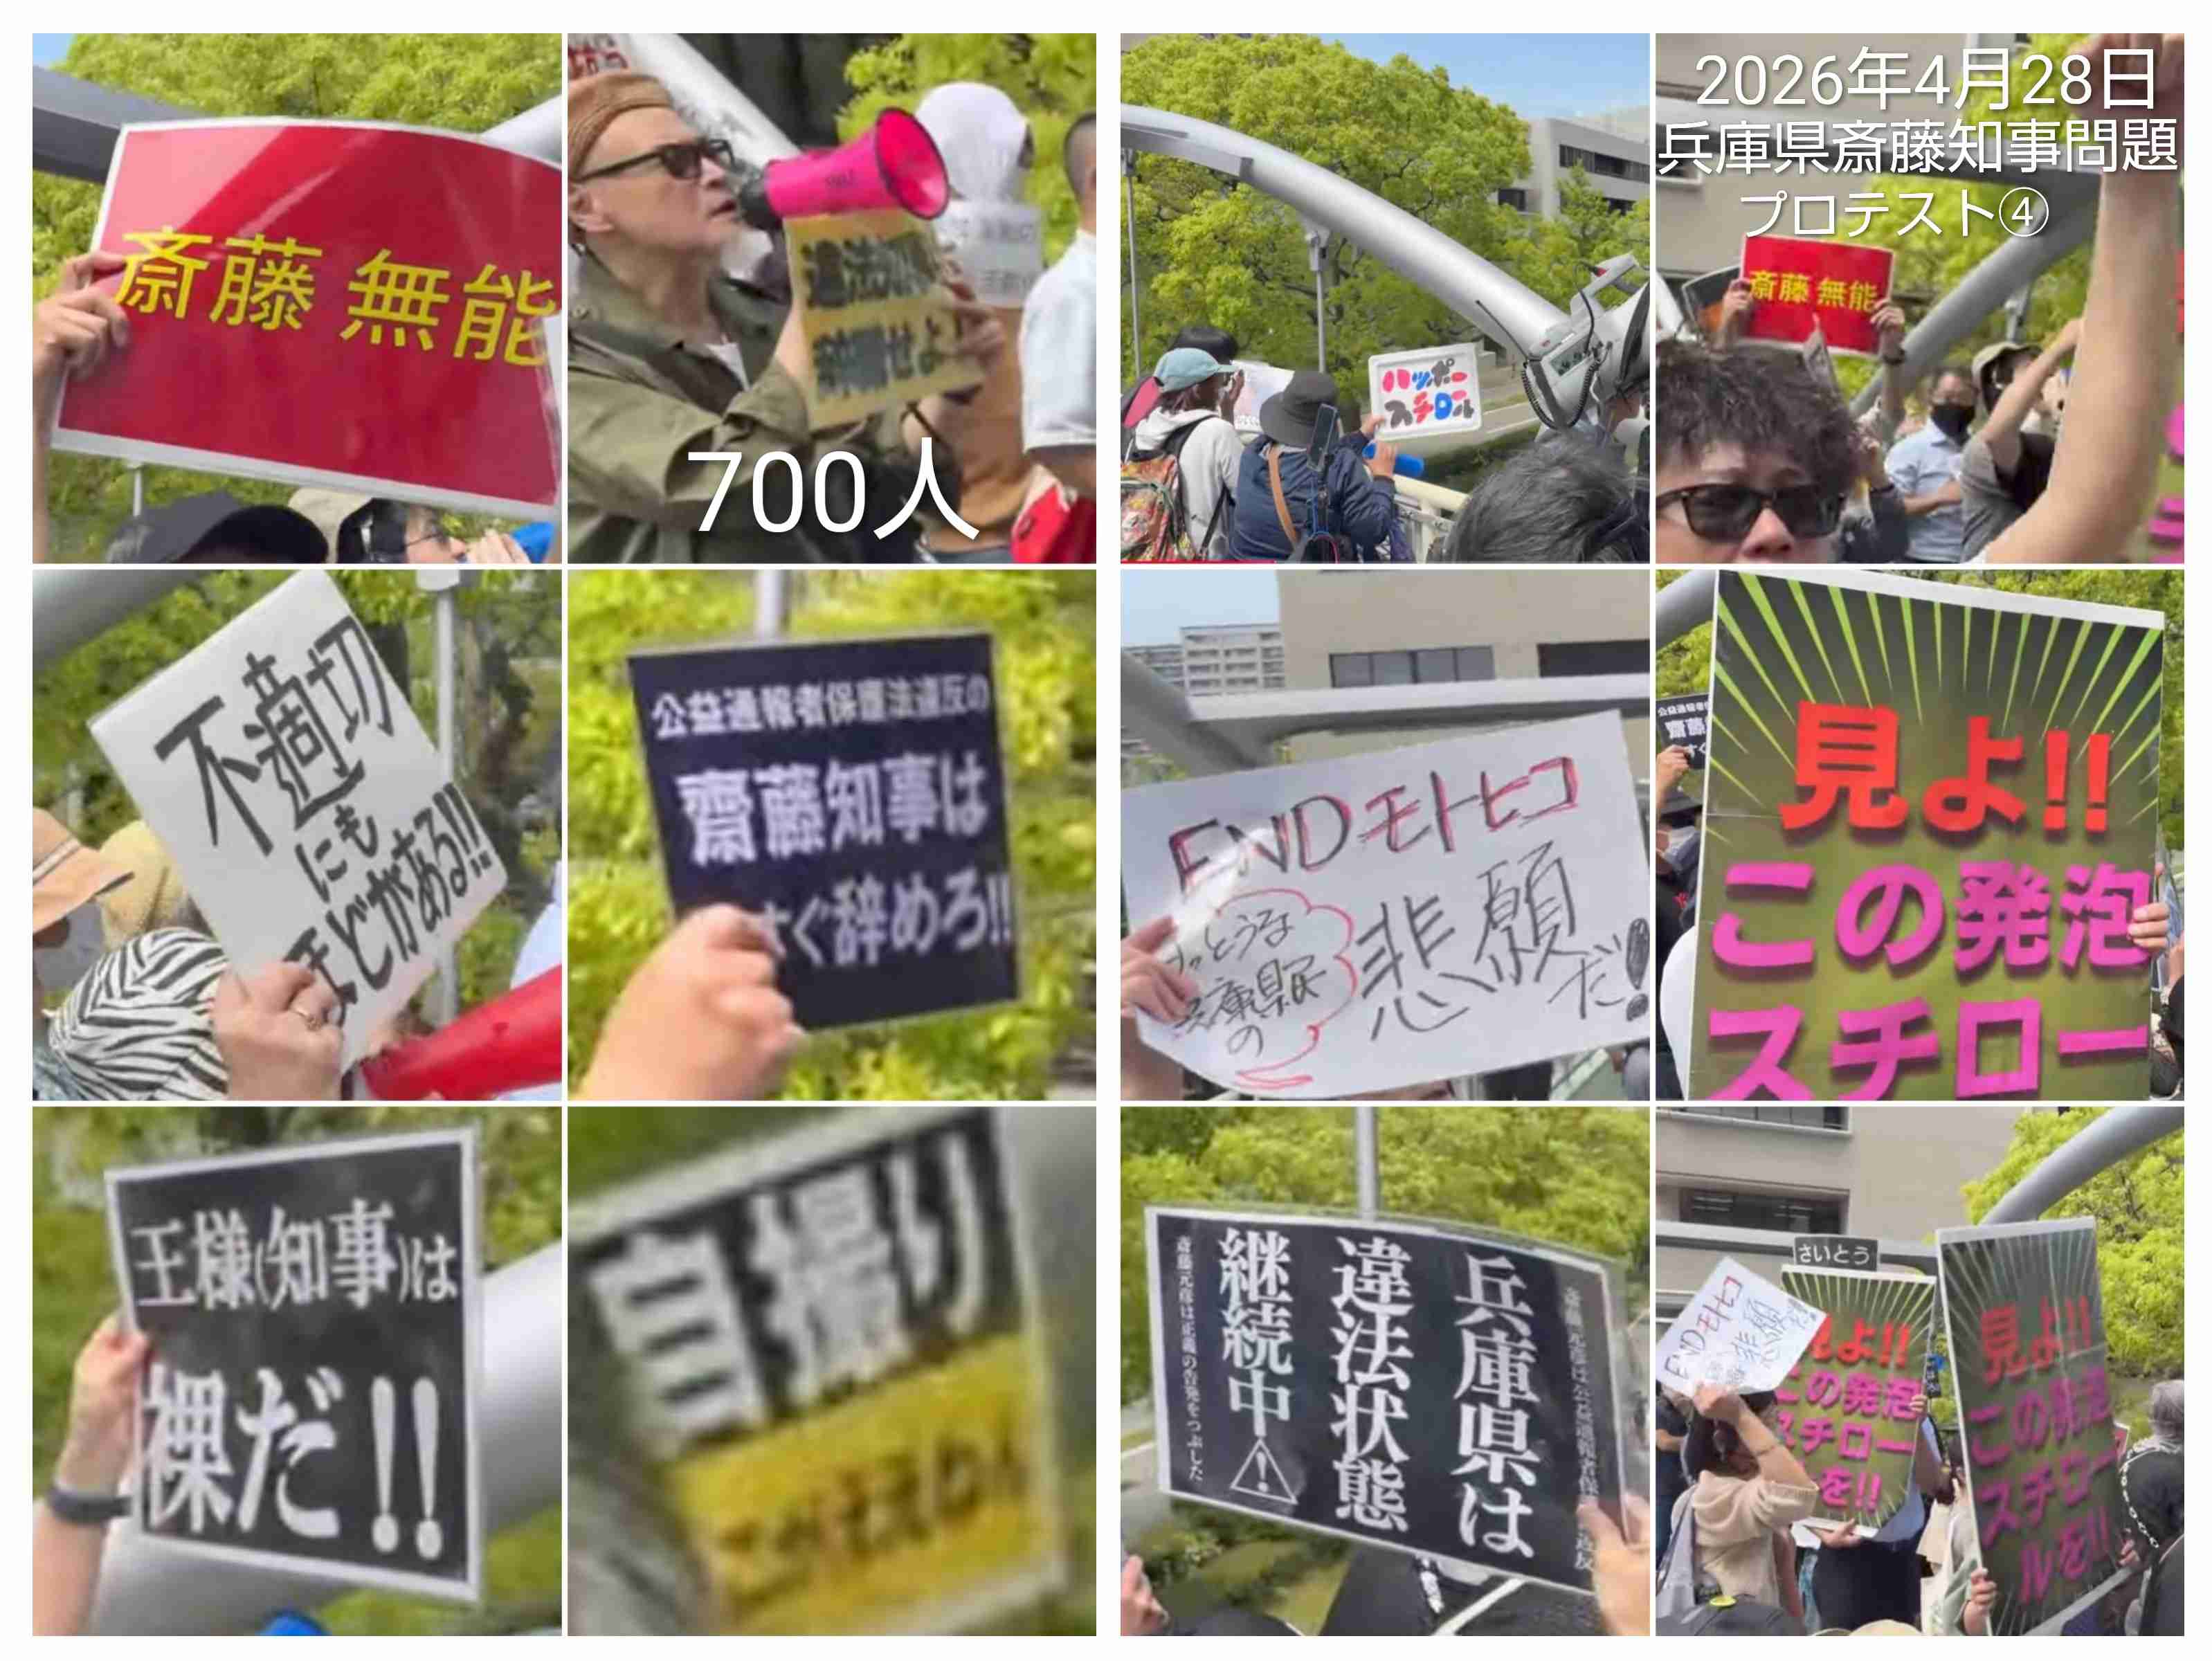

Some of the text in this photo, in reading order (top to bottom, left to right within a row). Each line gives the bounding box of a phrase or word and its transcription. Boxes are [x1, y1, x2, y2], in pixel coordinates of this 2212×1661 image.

[114, 226, 556, 367] 斎藤 無能
[1382, 358, 1468, 392] ハッポー
[1384, 390, 1474, 429] スチロール
[154, 615, 394, 857] 不適切
[1779, 699, 2113, 833] 見よ!!
[295, 804, 379, 903] にも
[1712, 860, 2152, 973] この発泡
[1226, 1024, 1264, 1058] の
[1705, 997, 2148, 1101] スチロー
[130, 1197, 459, 1310] 王様(知事)は
[588, 1132, 985, 1455] 自撮り
[1799, 1244, 1870, 1265] さいとう
[1218, 1227, 1294, 1439] 継続中
[1331, 1236, 1413, 1534] 違法状態
[144, 1363, 444, 1560] 裸だ!!
[1451, 1253, 1541, 1559] 兵庫県は
